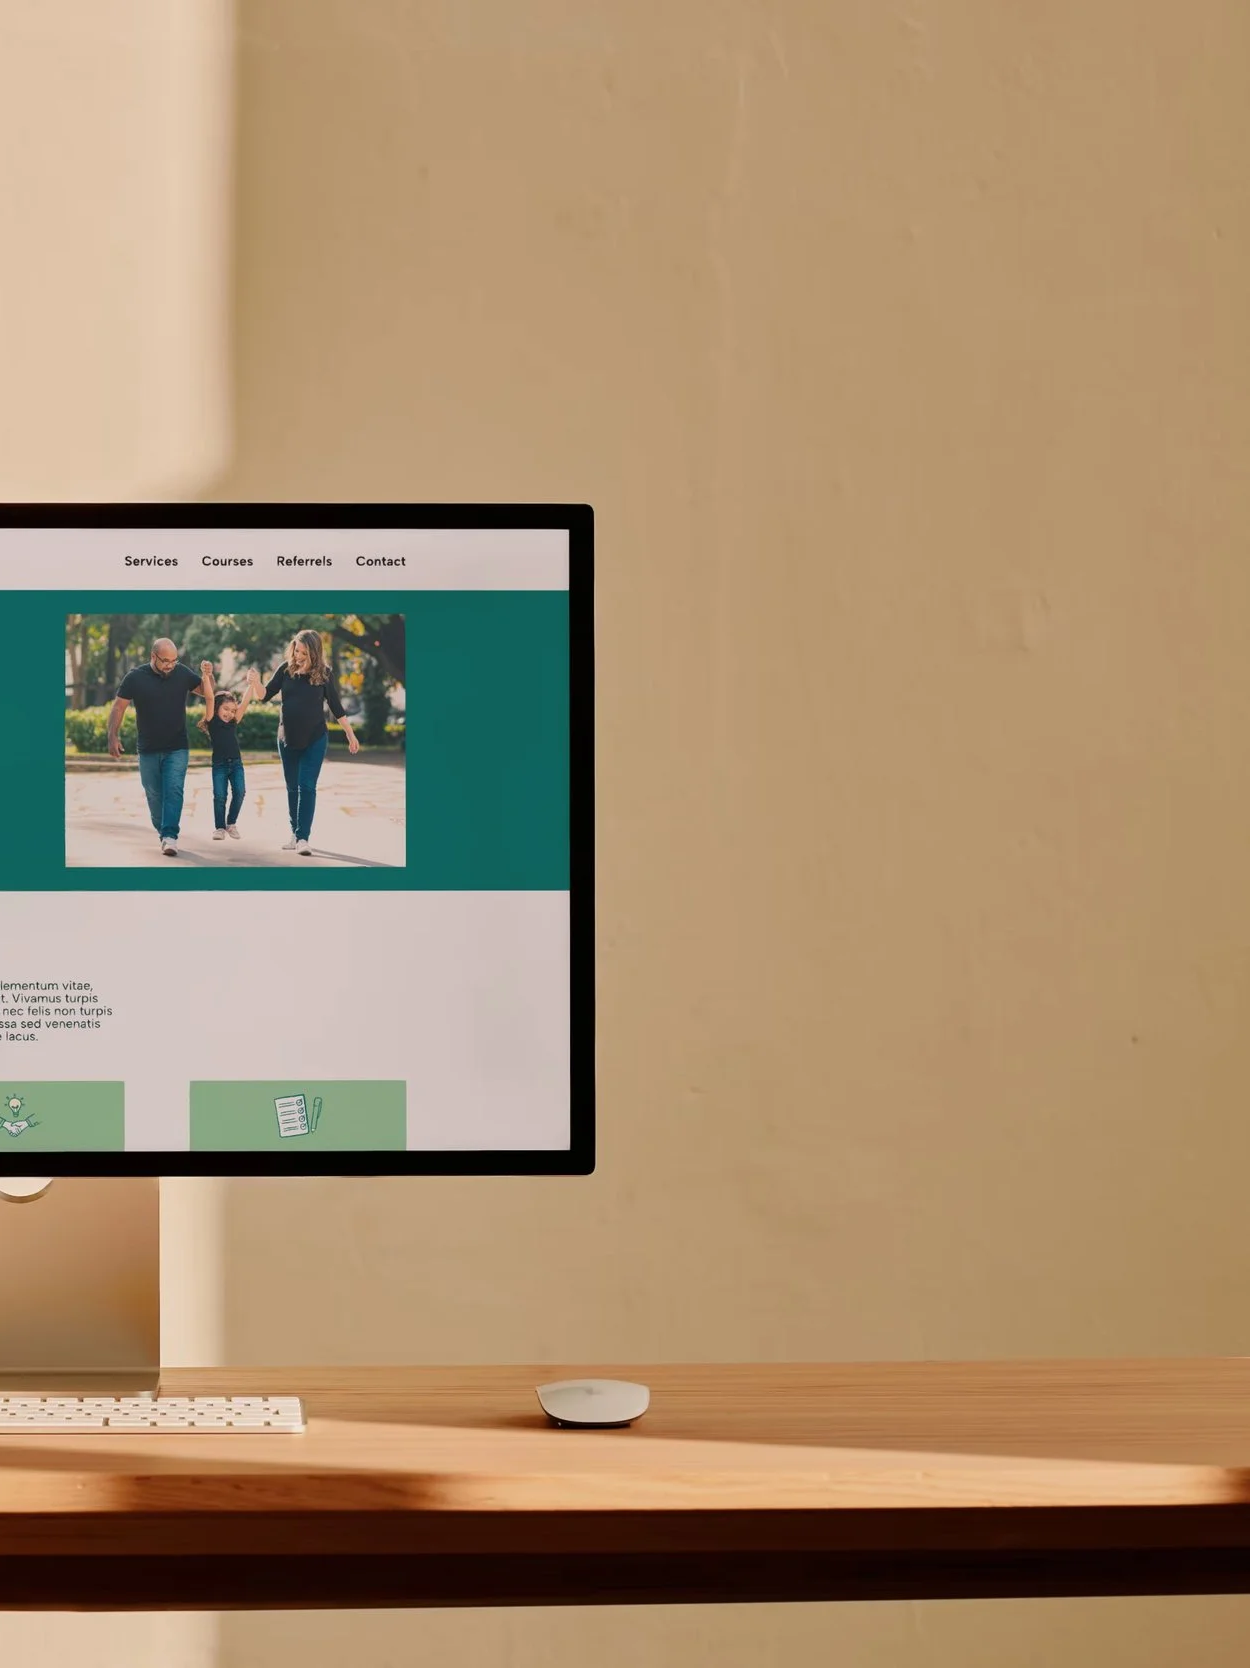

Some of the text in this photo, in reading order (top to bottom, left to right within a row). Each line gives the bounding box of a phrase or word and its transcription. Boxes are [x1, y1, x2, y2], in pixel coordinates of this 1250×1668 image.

[124, 555, 178, 567] Services
[202, 555, 254, 567] Courses
[277, 555, 333, 567] Referrels
[355, 555, 406, 567] Contact
[62, 980, 93, 992] vitae,
[12, 993, 62, 1003] Vivamus
[65, 993, 98, 1005] turpis
[2, 1008, 24, 1016] nec
[27, 1006, 51, 1016] felis
[54, 1008, 76, 1016] non
[80, 1006, 113, 1018] turpis
[20, 1019, 41, 1029] sed
[45, 1018, 101, 1029] venenatis
[6, 1031, 38, 1041] lacus.
